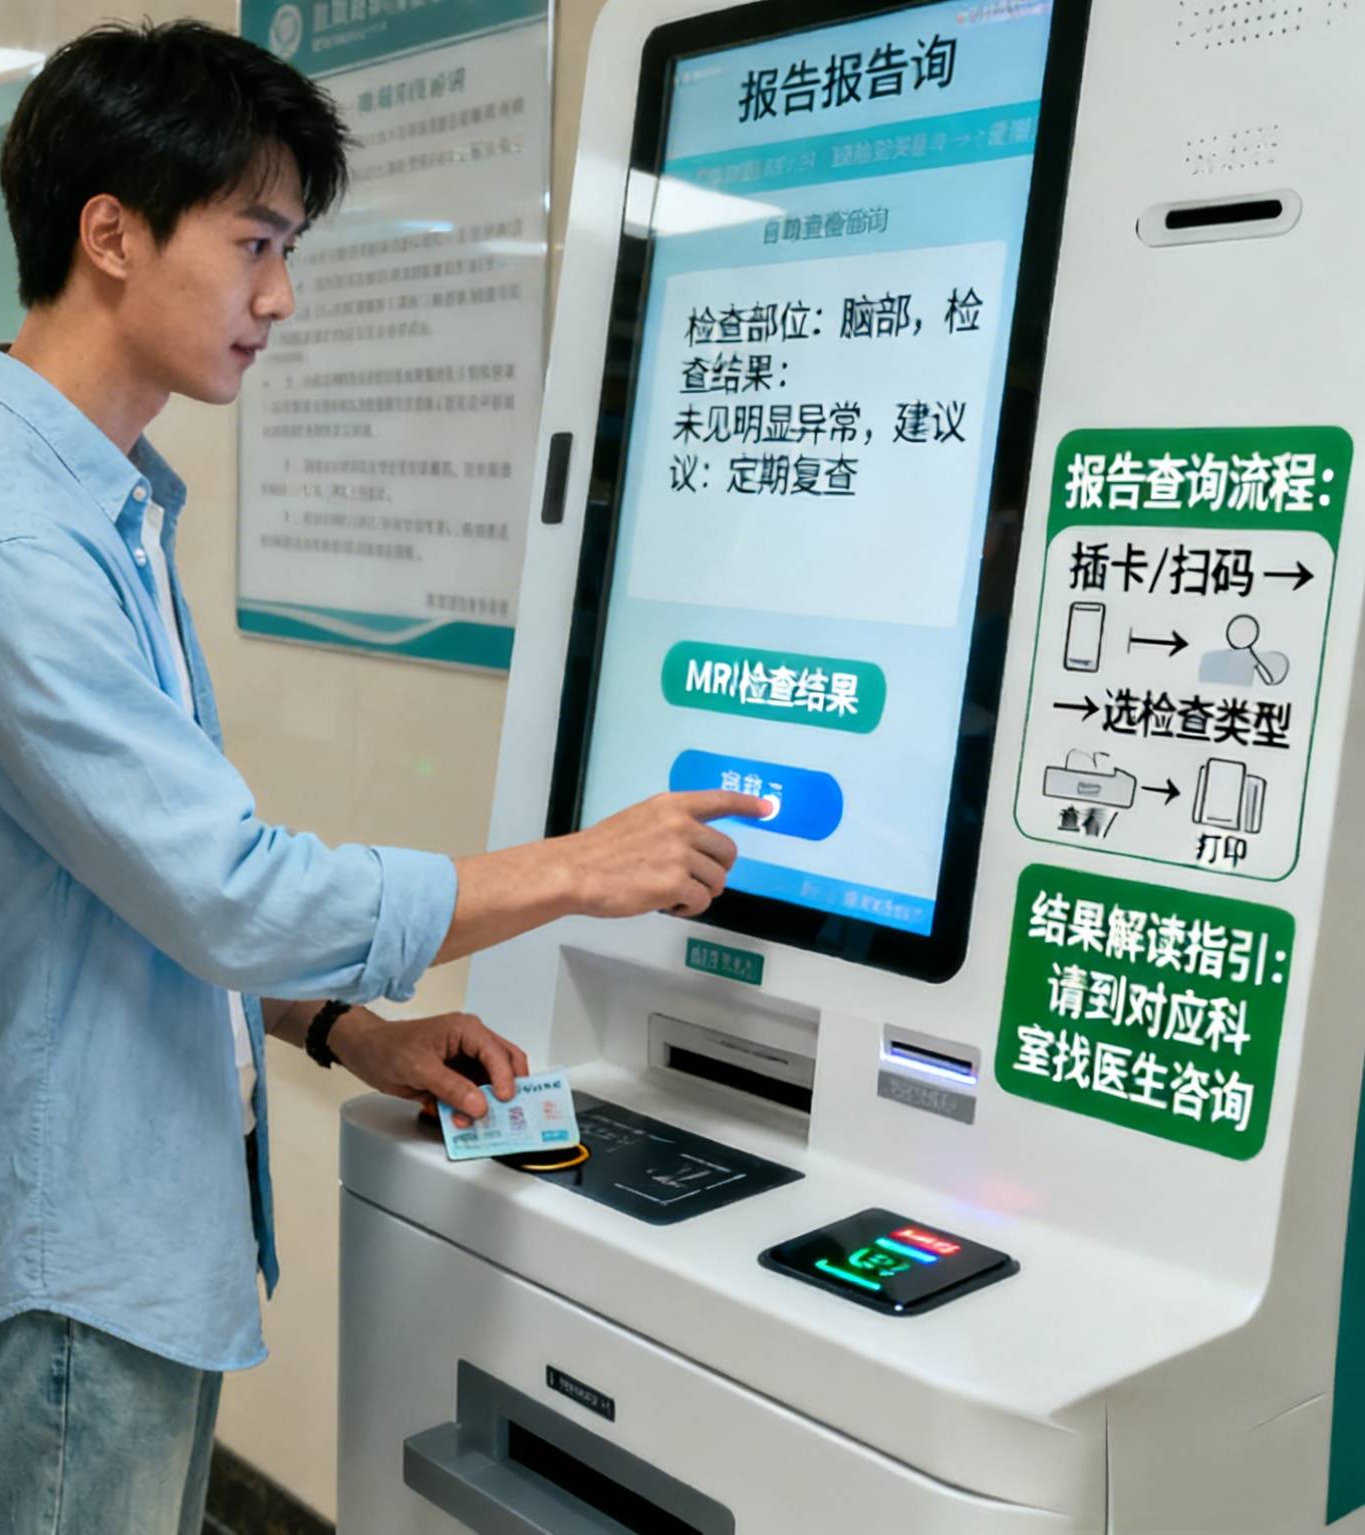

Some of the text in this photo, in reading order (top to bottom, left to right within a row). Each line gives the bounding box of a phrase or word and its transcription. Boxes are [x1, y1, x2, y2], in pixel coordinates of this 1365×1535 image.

[738, 33, 957, 123] 报告报告询
[1065, 451, 1334, 513] 报告查询流程：
[1069, 541, 1254, 597] 插卡/扫码
[685, 659, 859, 718] MRI检查结果
[1101, 688, 1292, 750] 选检查类型
[1196, 832, 1248, 868] 打印
[1028, 889, 1287, 986] 结果解读指引：
[1047, 961, 1252, 1056] 请到对应科
[1012, 1023, 1255, 1132] 室找医生咨询
